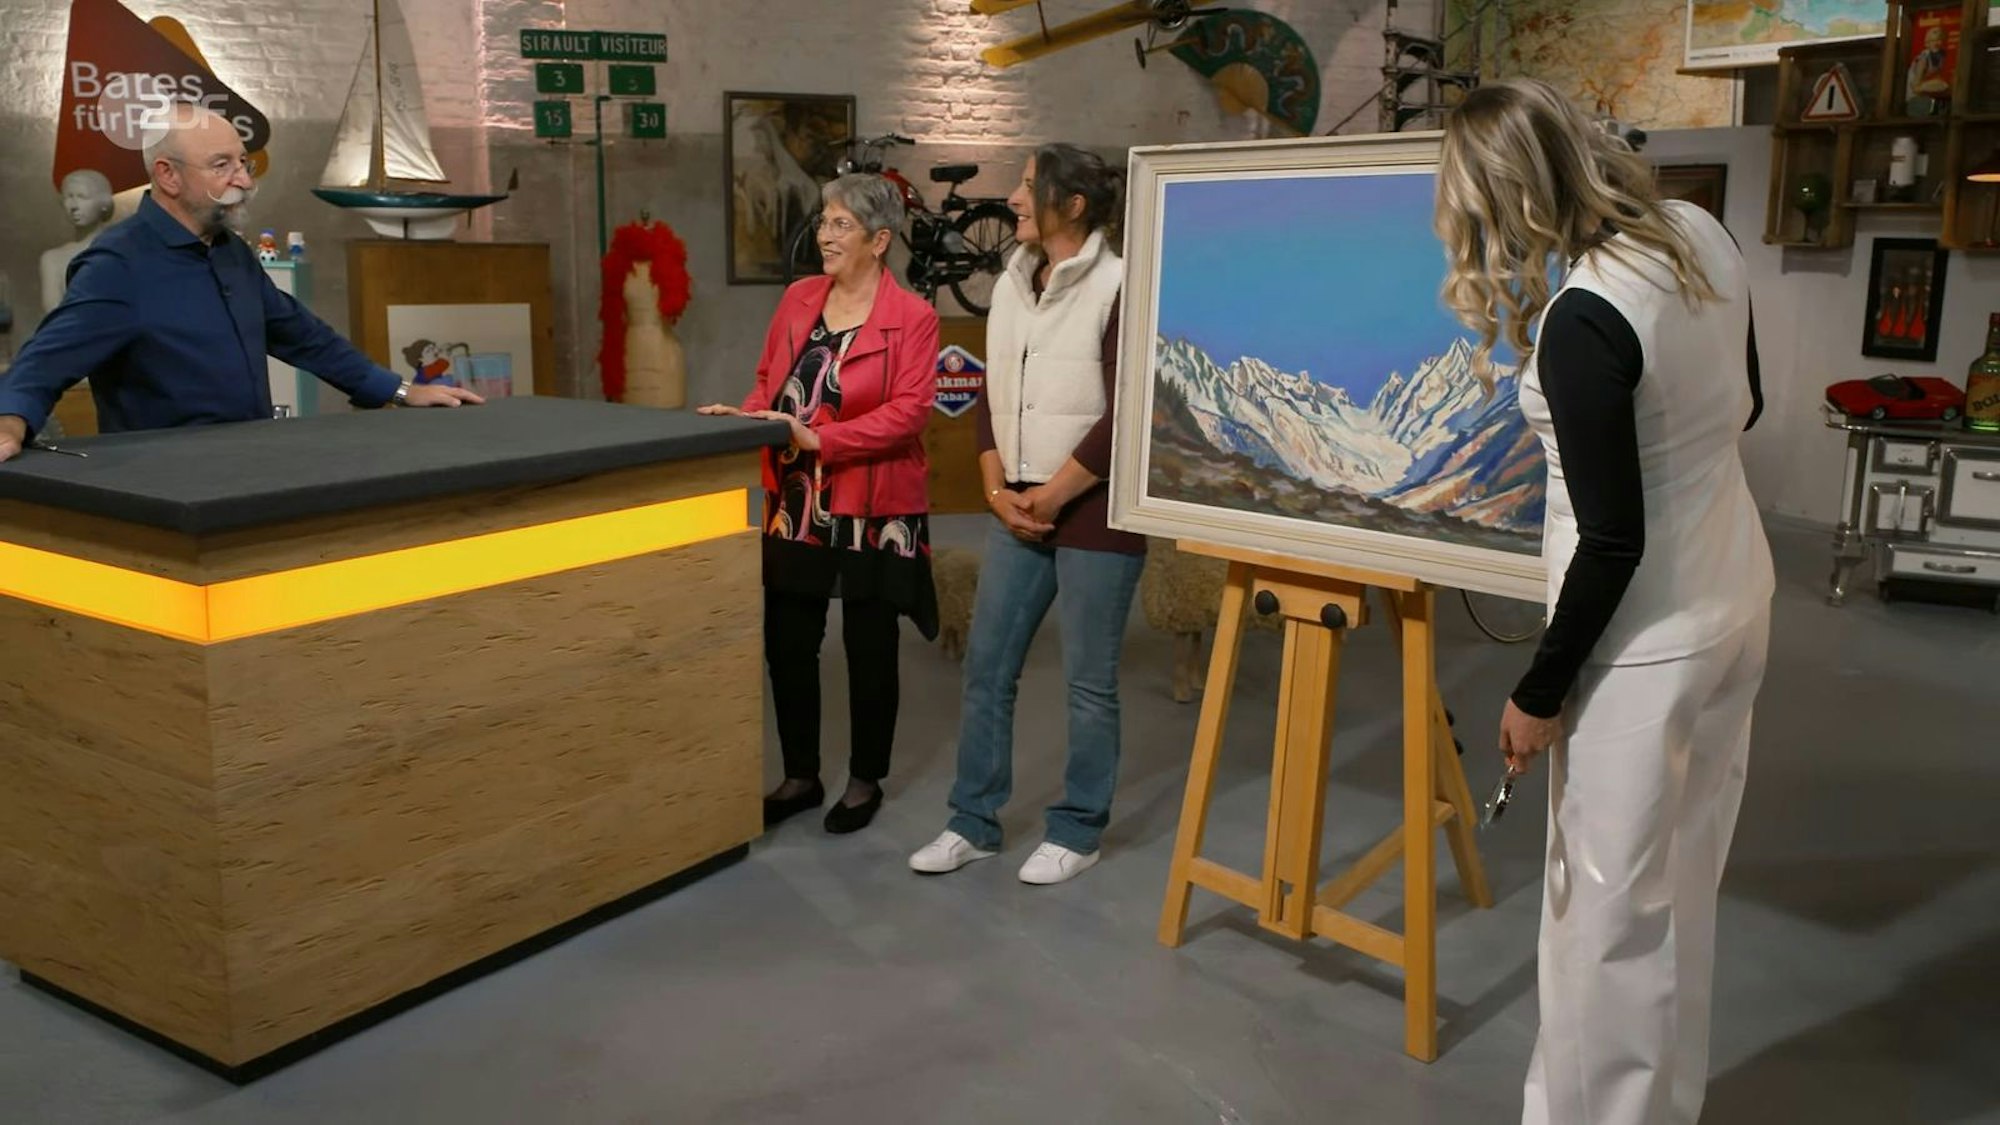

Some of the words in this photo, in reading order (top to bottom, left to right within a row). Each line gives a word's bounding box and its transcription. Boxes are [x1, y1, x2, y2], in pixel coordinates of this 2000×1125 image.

[523, 35, 591, 52] SIRAULT
[70, 61, 203, 101] Bares
[553, 70, 566, 87] 3
[73, 104, 121, 132] für
[545, 110, 564, 127] 15
[639, 112, 659, 128] 30
